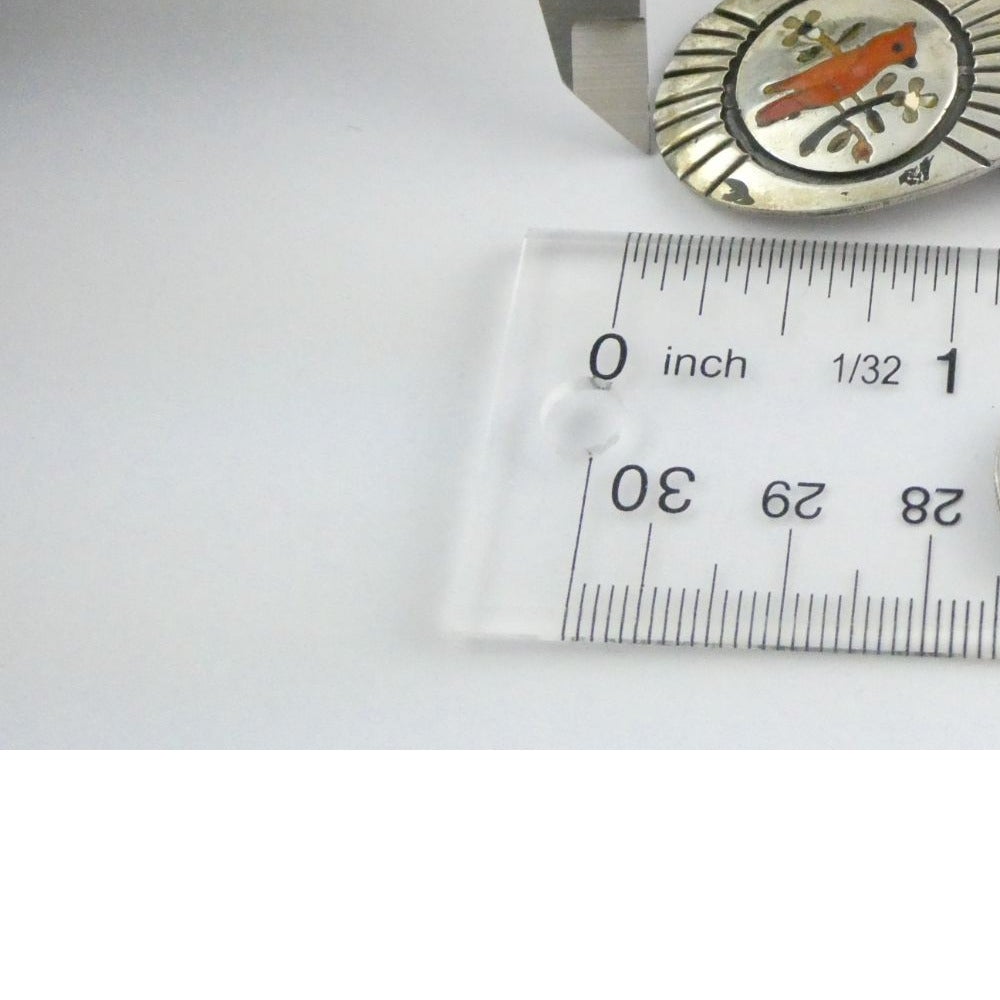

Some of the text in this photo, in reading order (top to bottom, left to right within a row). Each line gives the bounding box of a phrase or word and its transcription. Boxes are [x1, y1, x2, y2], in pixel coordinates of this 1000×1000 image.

[589, 333, 629, 381] 0
[663, 345, 748, 380] inch
[832, 353, 903, 387] 1/32
[936, 347, 958, 395] 1
[611, 464, 697, 516] 30
[761, 480, 827, 521] 29
[901, 486, 966, 527] 28
